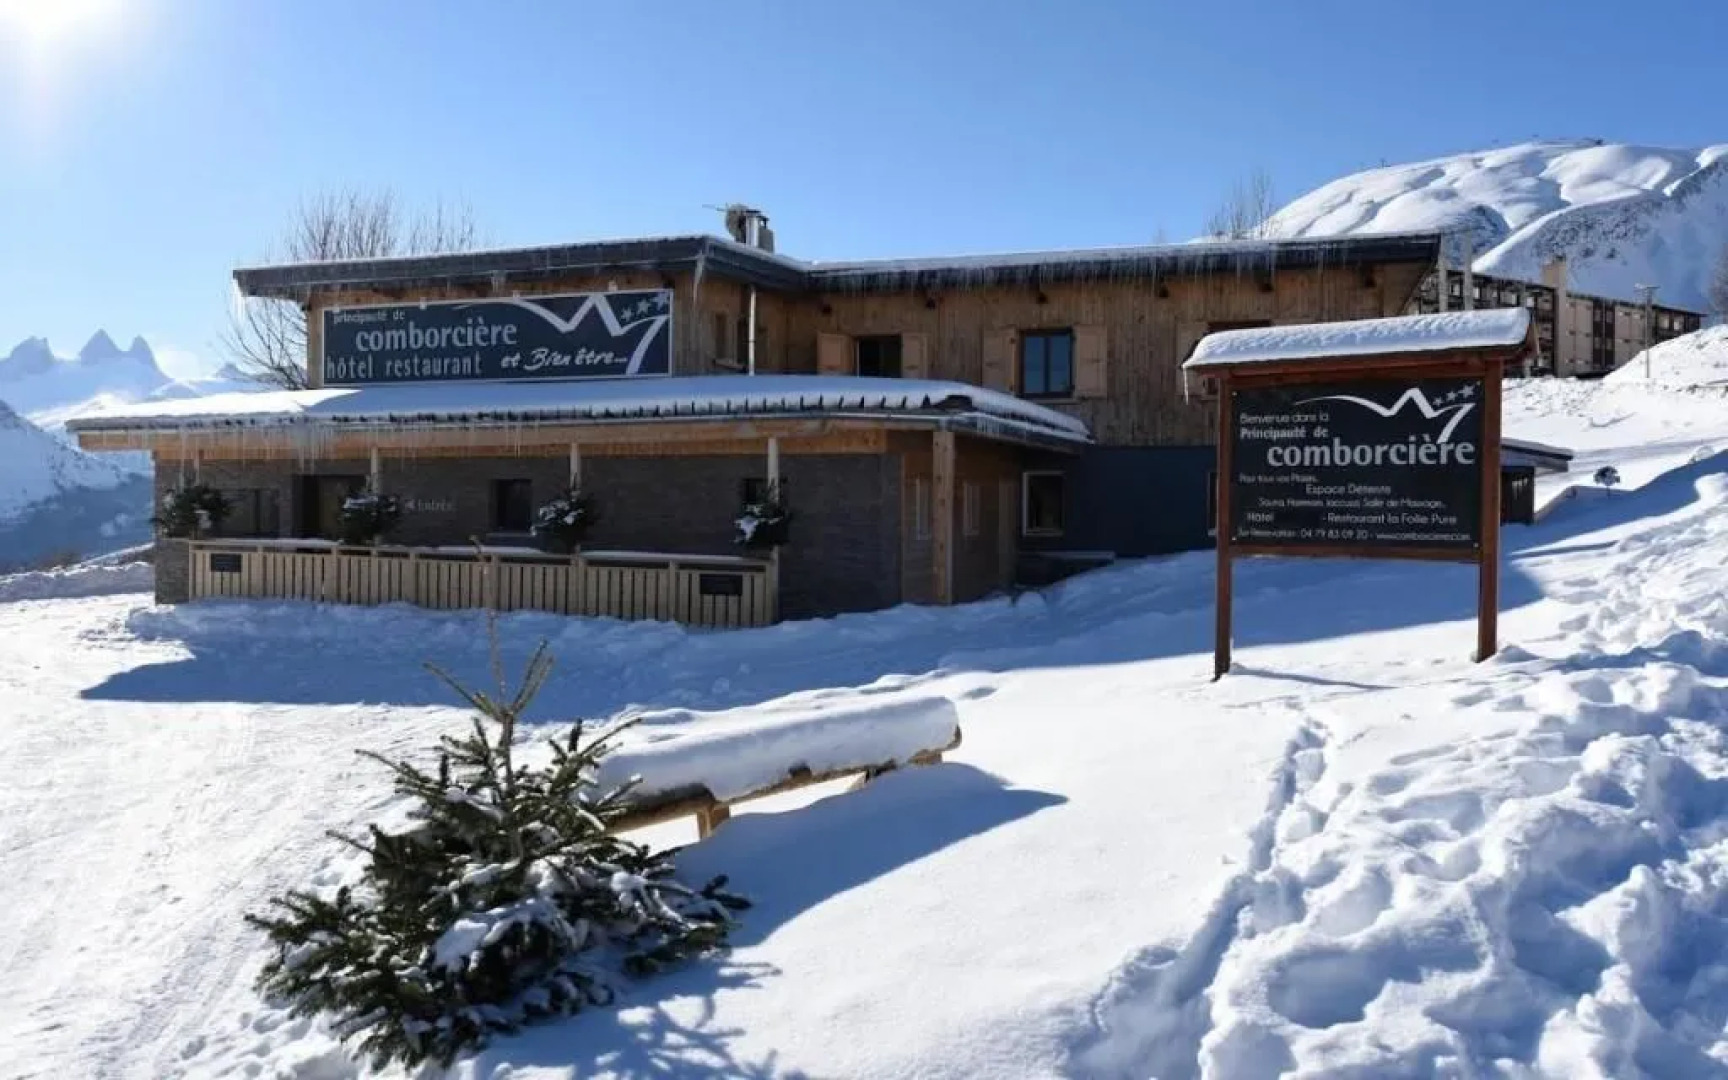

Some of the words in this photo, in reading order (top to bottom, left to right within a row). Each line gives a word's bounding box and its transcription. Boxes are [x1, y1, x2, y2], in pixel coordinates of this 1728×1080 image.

[356, 316, 518, 352] comborcière
[326, 353, 374, 380] hôtel
[386, 350, 481, 378] restaurant
[501, 352, 521, 369] et
[523, 346, 571, 371] Bien
[1240, 412, 1290, 424] Bienvenue
[1292, 413, 1317, 423] dans
[1319, 411, 1329, 423] la
[1240, 426, 1307, 442] Principauté
[1313, 425, 1329, 438] de
[1266, 433, 1476, 467] comborcière
[1305, 483, 1346, 496] Espace
[1347, 482, 1392, 495] Détente
[1246, 512, 1275, 523] Hôtel
[1327, 512, 1385, 525] Restaurant
[1386, 512, 1399, 524] la
[1401, 512, 1428, 524] Folie
[1431, 512, 1457, 525] Pure
